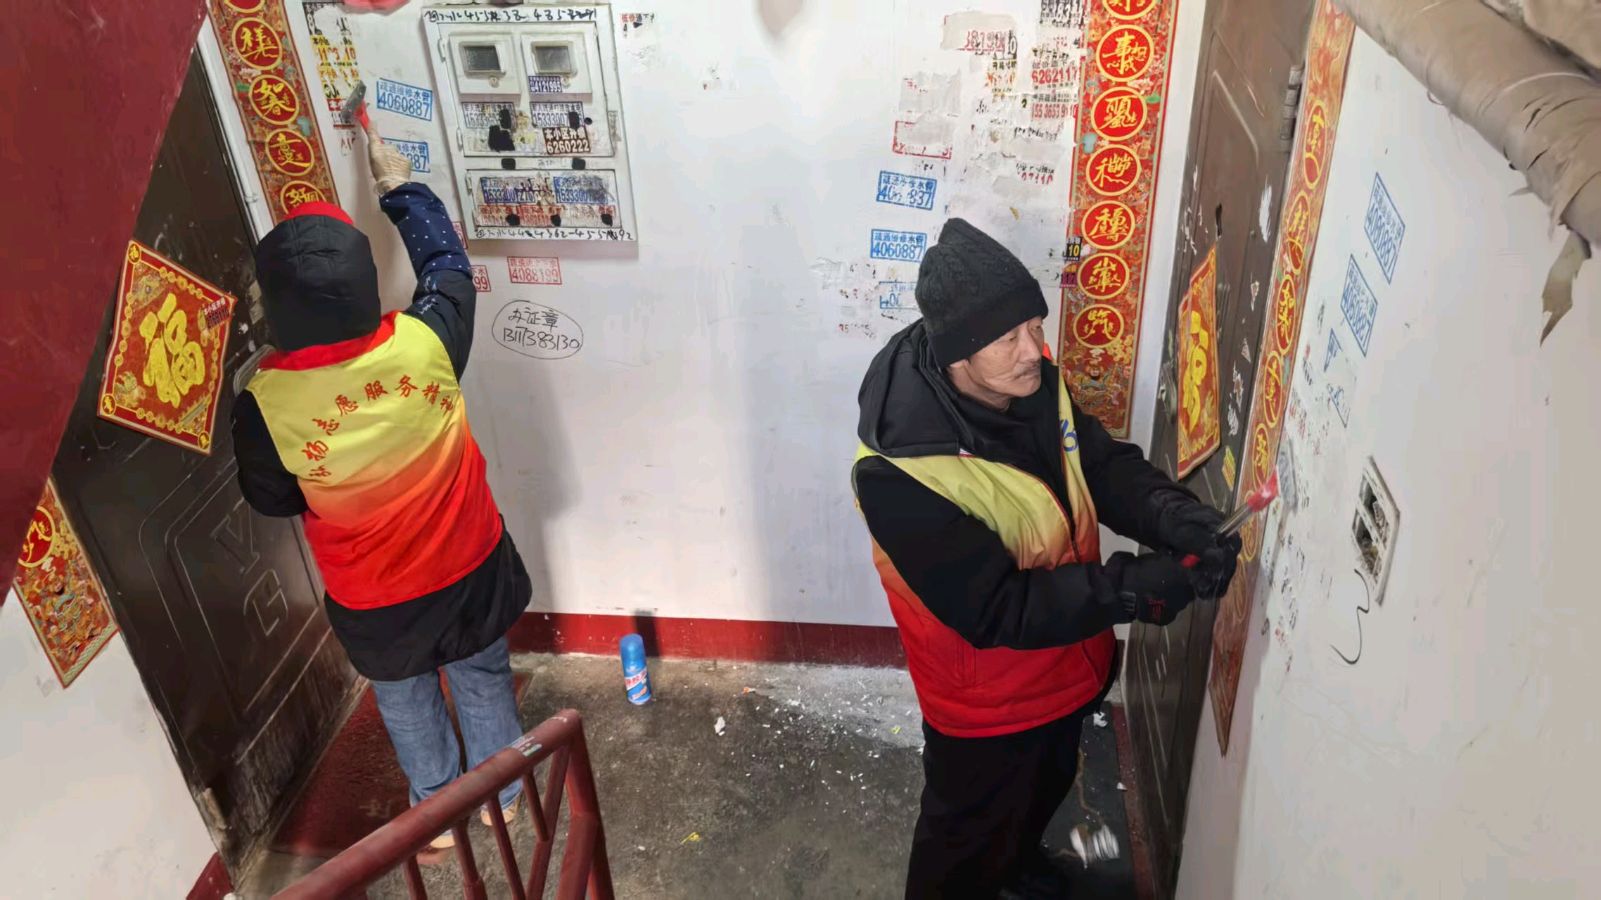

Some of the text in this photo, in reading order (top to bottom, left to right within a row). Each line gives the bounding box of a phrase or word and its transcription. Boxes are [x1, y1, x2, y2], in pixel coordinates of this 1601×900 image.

[379, 93, 431, 118] 4060887
[547, 140, 590, 153] 6260222
[873, 243, 924, 259] 4060887
[139, 292, 205, 409] 福
